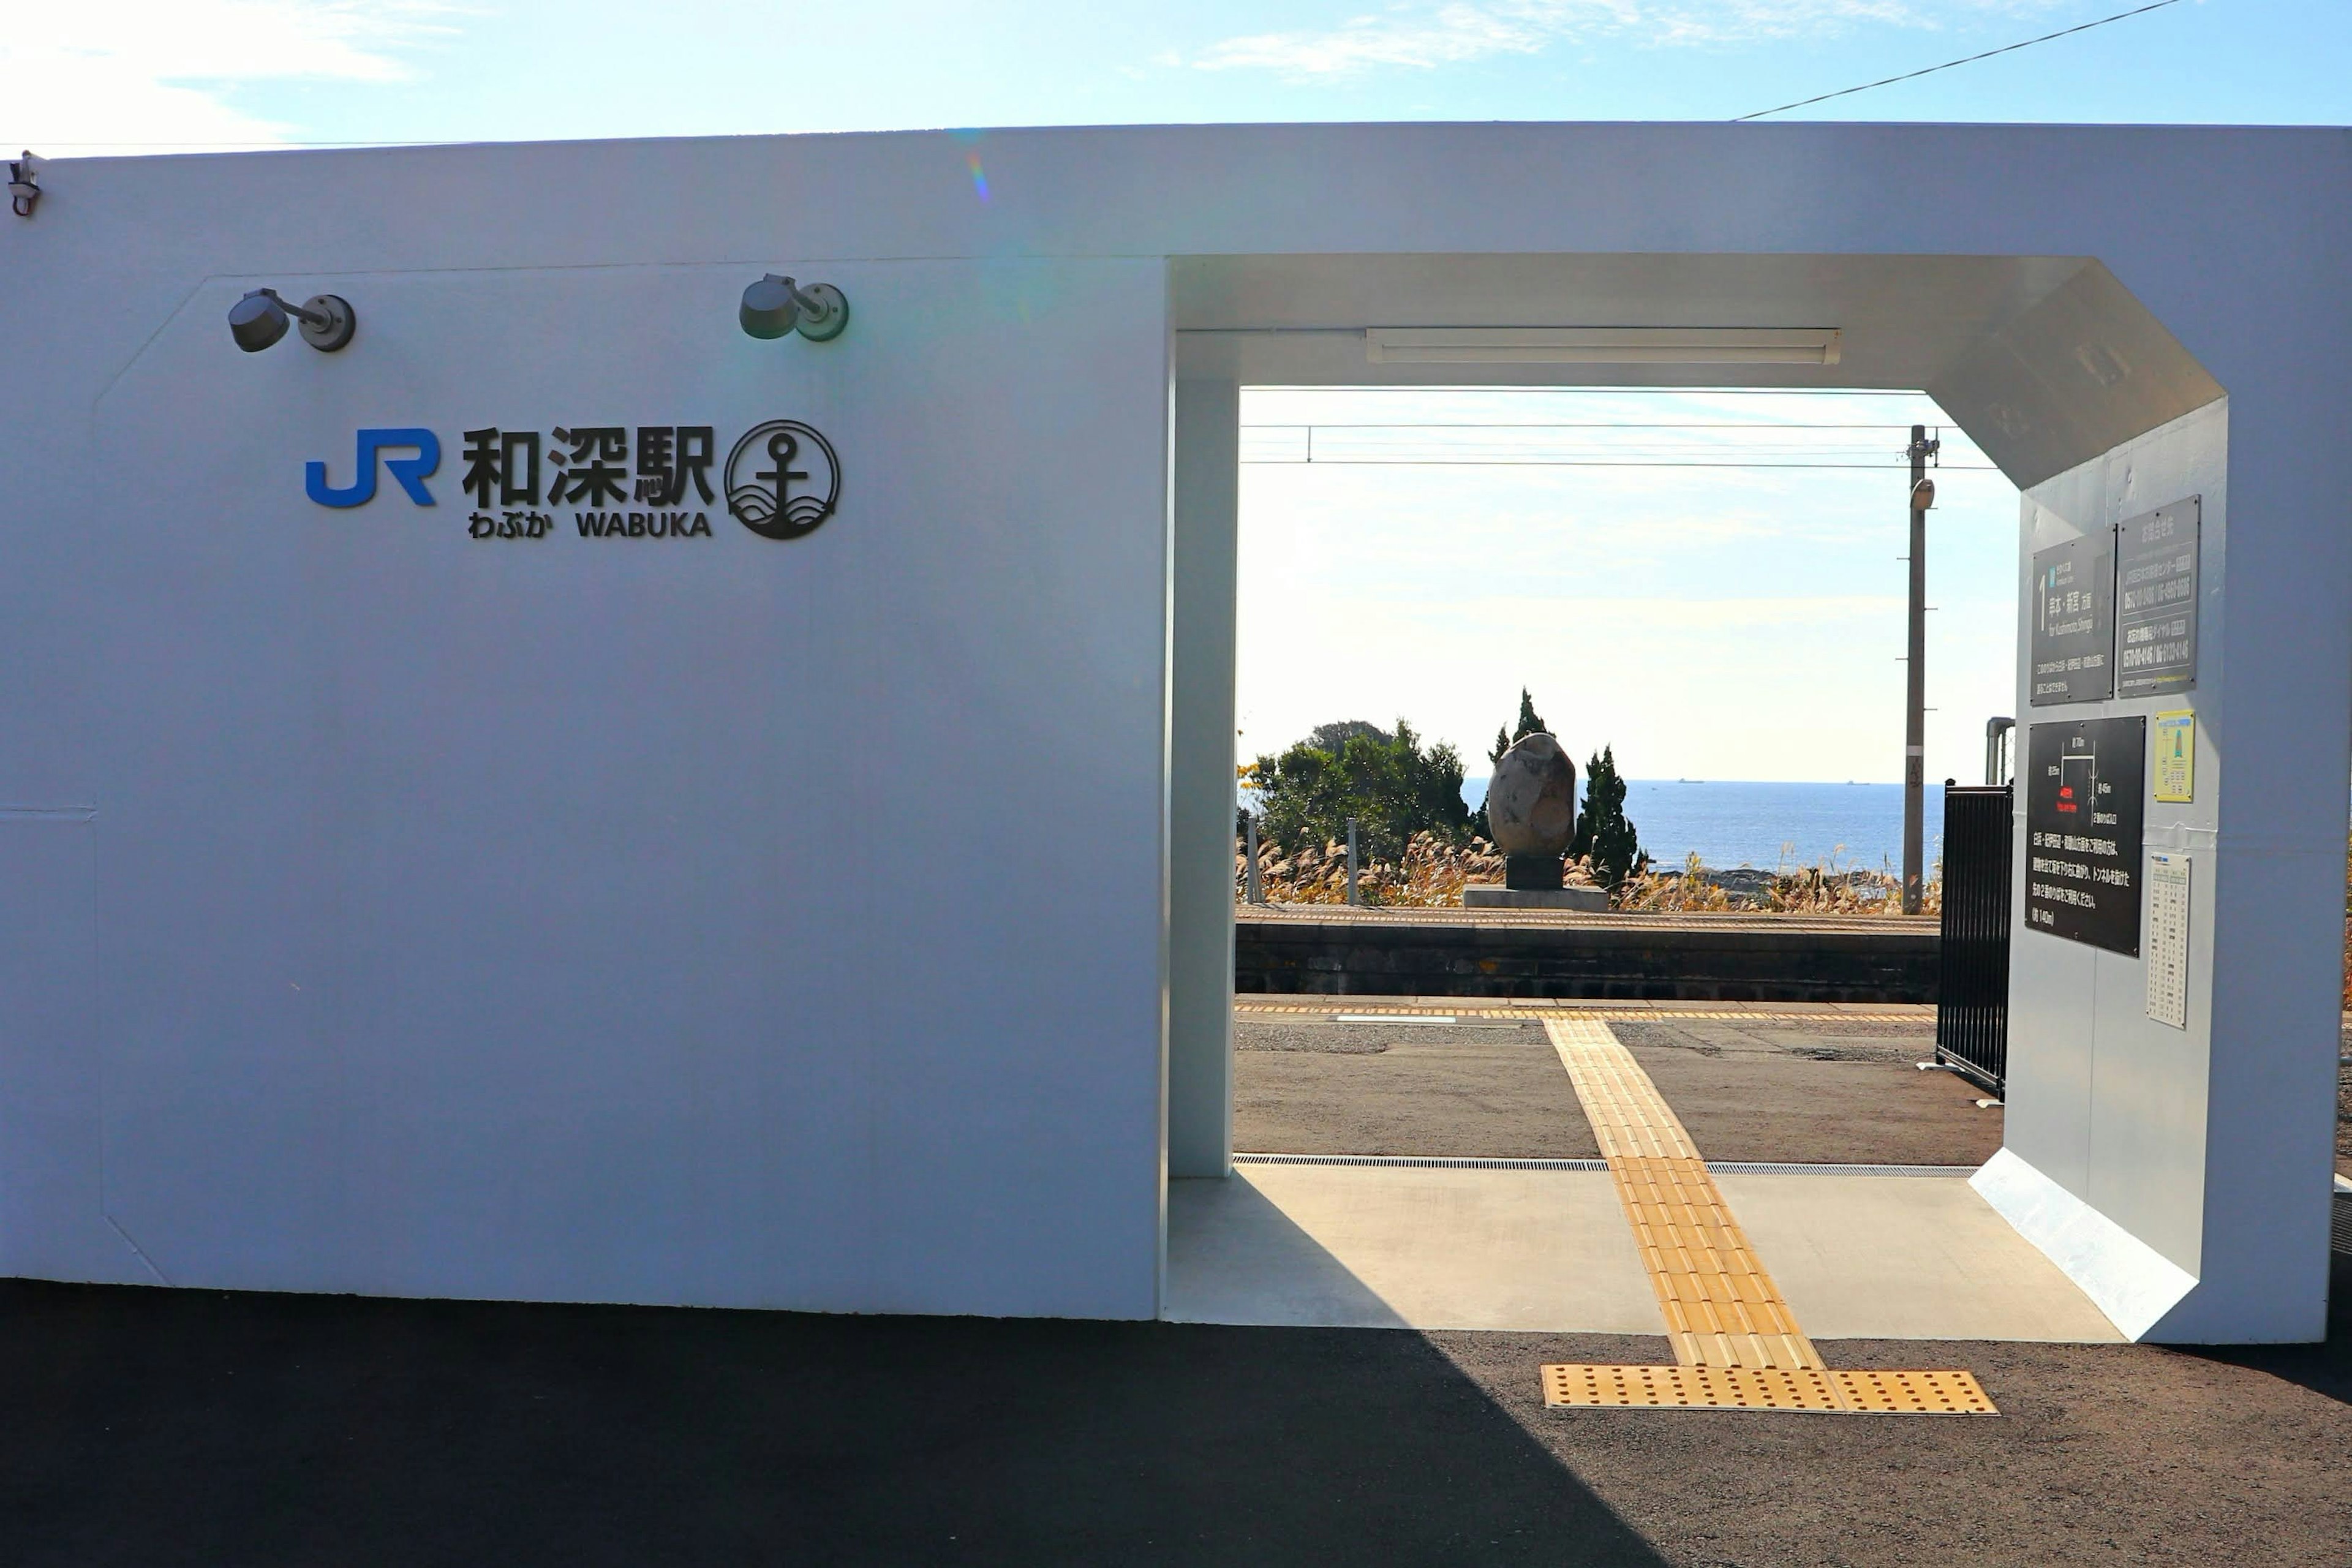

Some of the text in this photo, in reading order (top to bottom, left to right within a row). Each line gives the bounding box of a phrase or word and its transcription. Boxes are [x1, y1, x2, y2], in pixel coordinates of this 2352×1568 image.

[306, 428, 440, 507] JR
[462, 426, 715, 508] 和深駅
[468, 511, 552, 539] わぶか
[575, 512, 712, 537] WABUKA
[2039, 575, 2045, 631] 1
